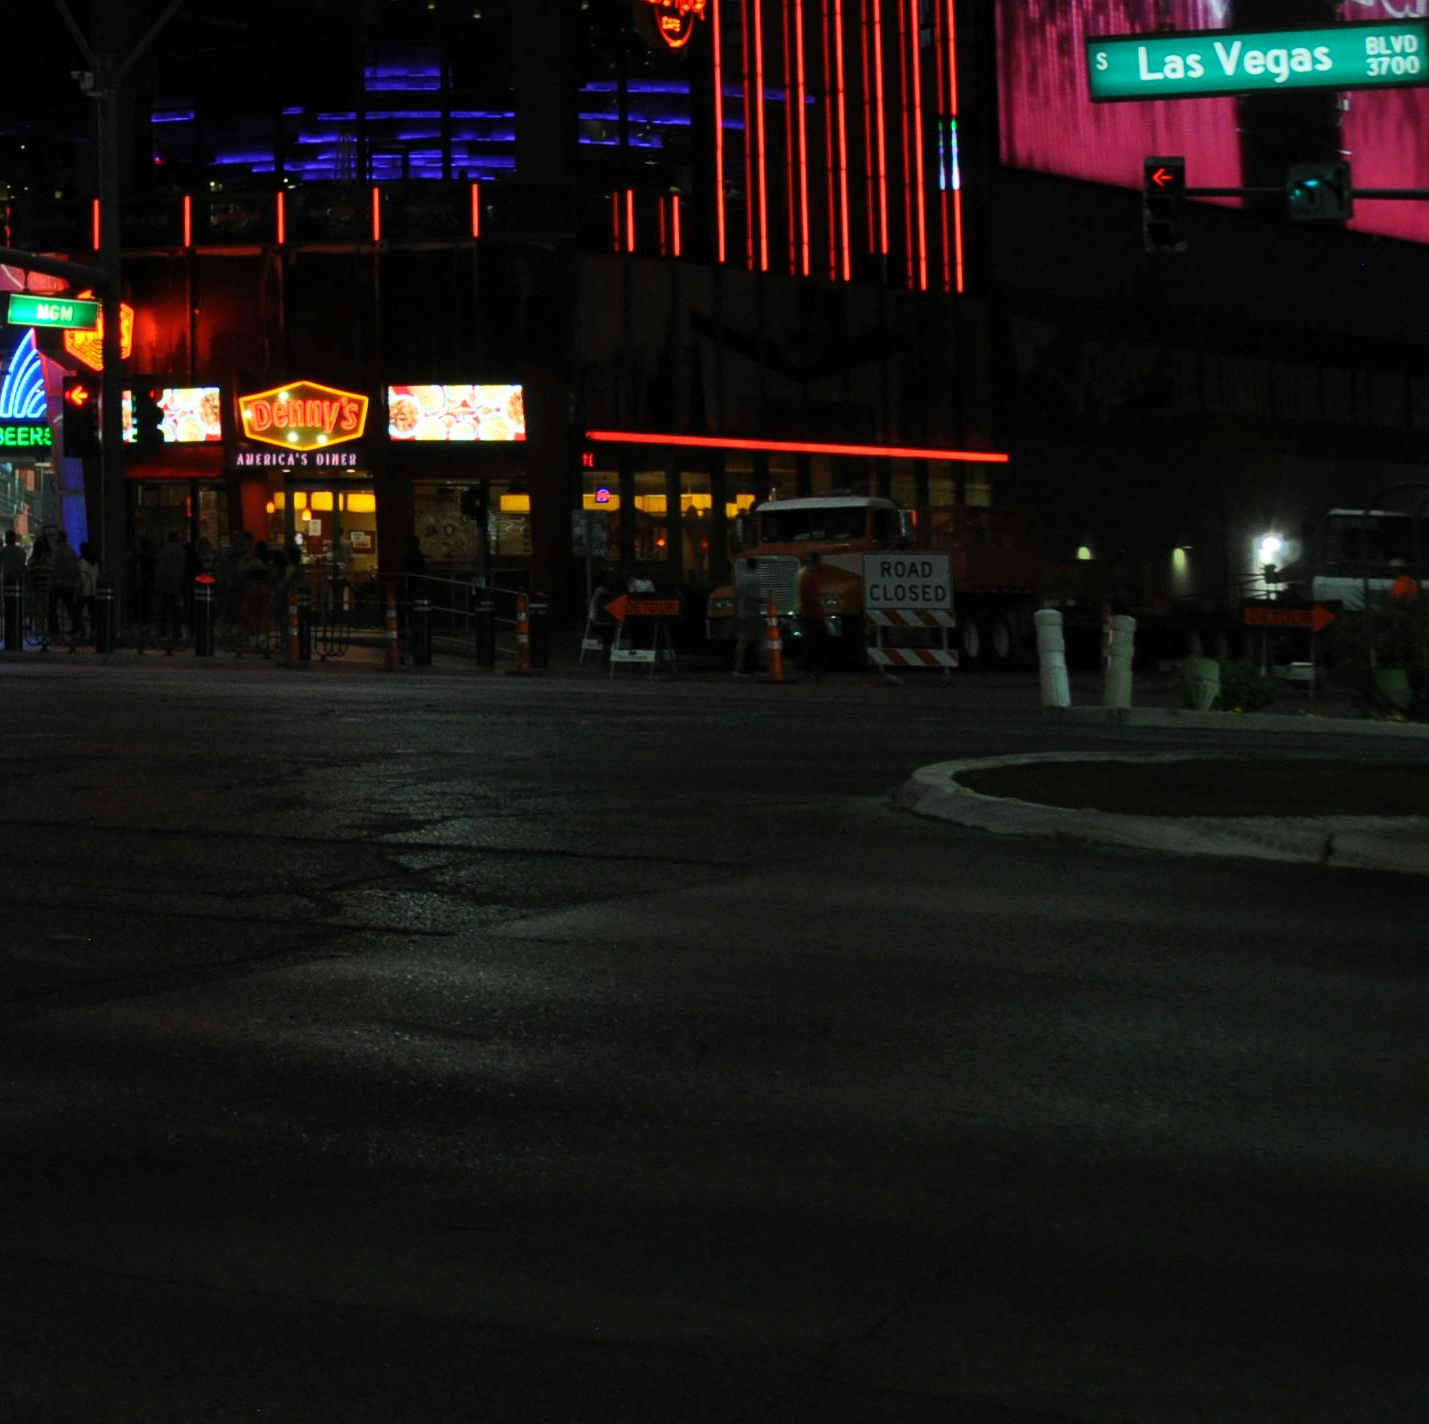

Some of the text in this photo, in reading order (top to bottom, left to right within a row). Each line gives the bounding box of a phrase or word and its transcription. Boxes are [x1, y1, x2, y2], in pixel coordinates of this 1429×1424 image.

[1095, 34, 1419, 83] S Las Vegas BLVD
[1365, 56, 1421, 77] 3700
[36, 303, 74, 322] MGM
[249, 396, 359, 433] Denny's
[237, 452, 357, 467] AMERICA'S DINER
[881, 561, 933, 578] ROAD
[870, 584, 946, 602] CLOSED
